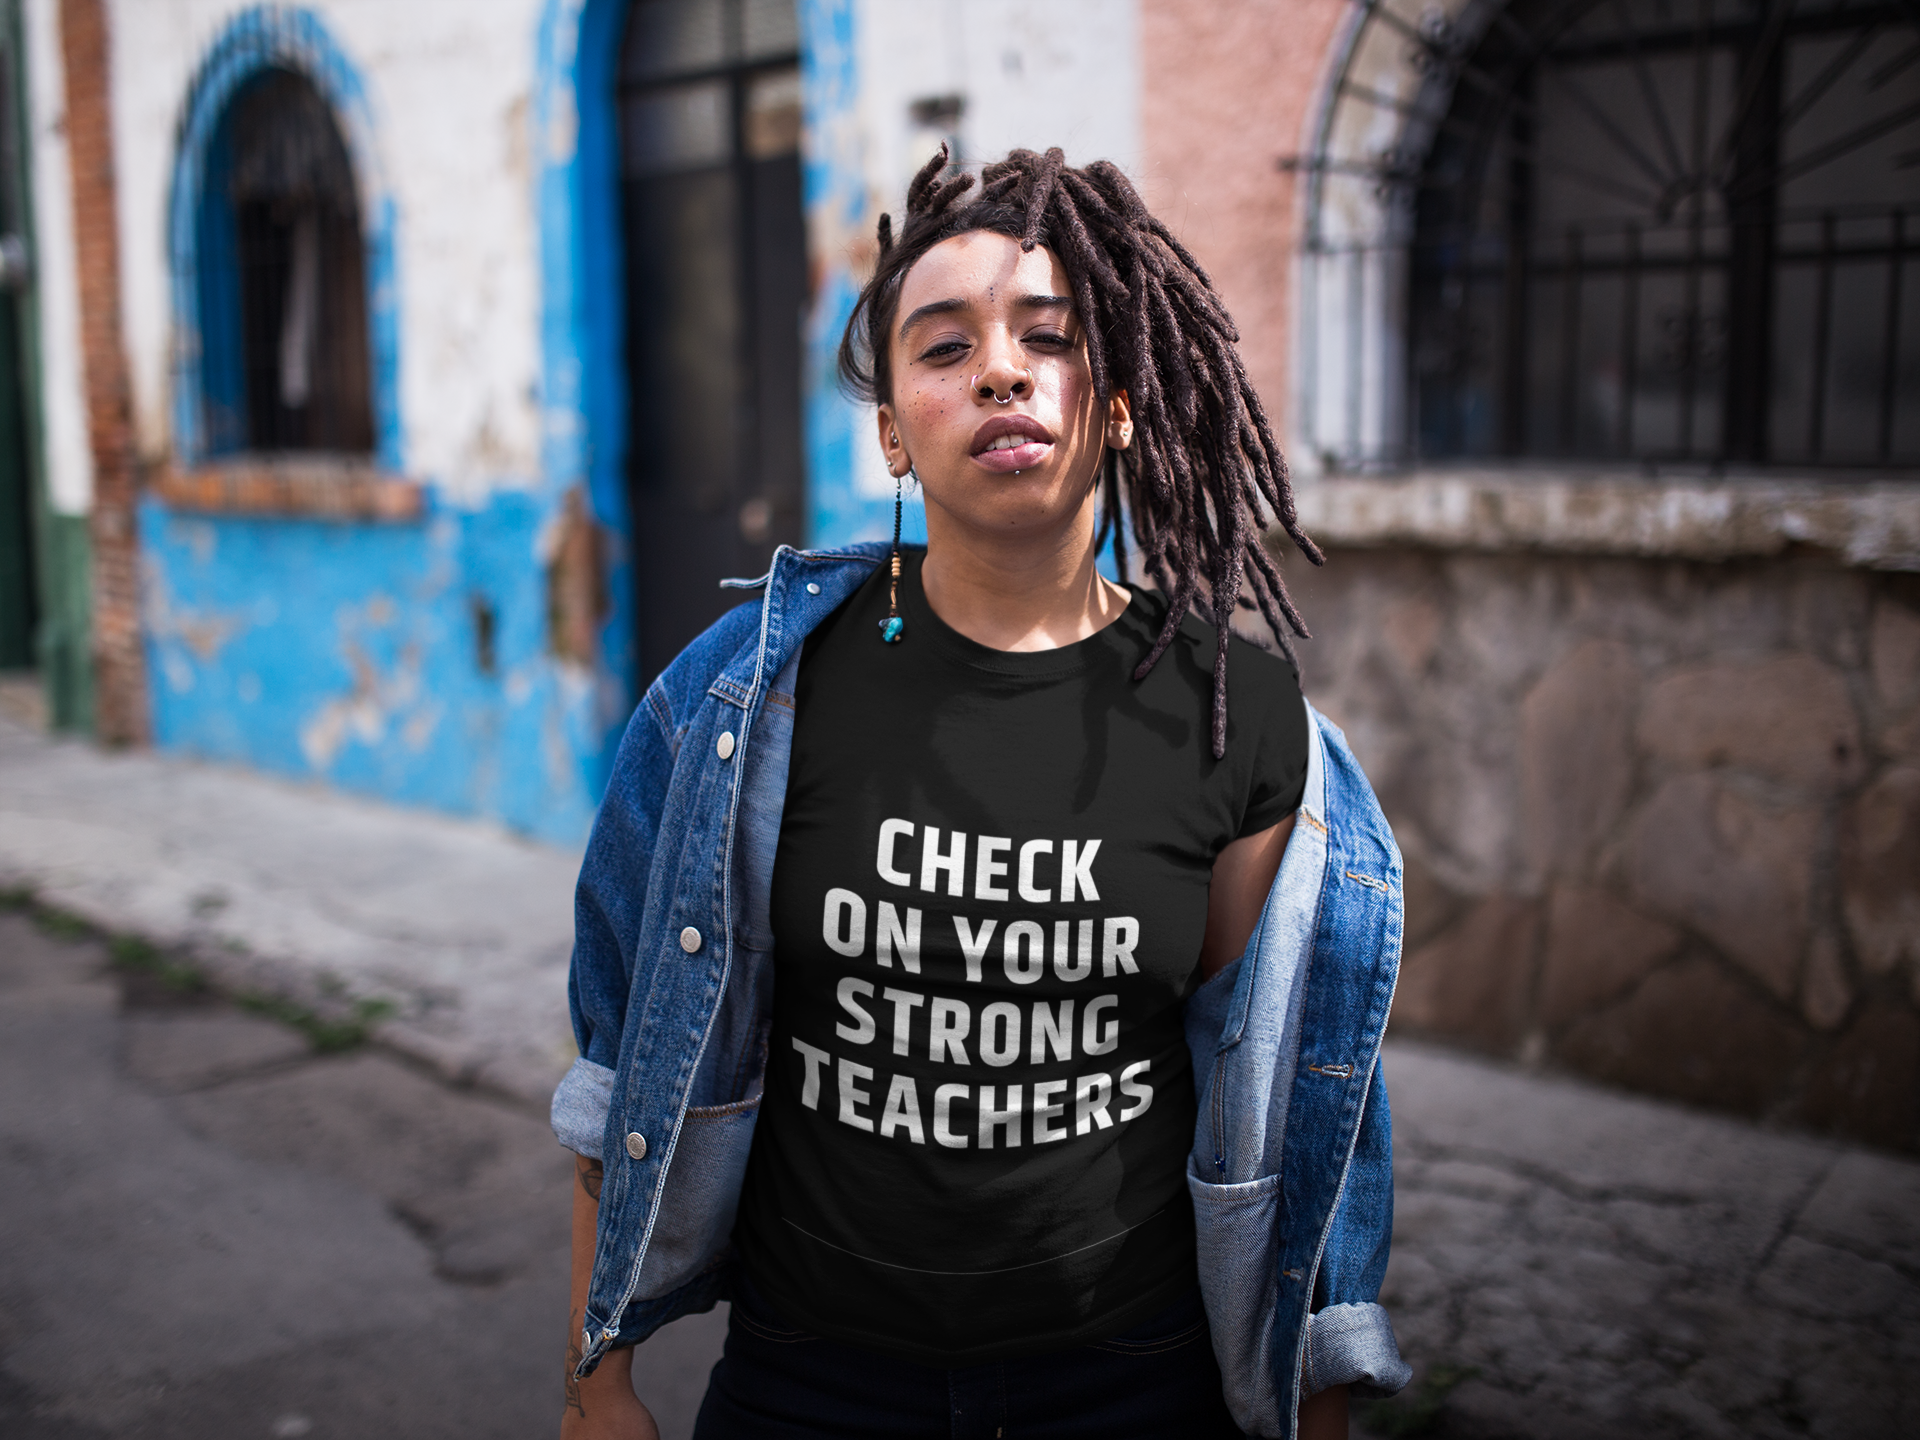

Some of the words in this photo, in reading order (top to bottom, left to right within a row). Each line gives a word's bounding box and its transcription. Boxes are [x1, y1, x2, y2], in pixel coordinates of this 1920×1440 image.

[876, 818, 1102, 903] CHECK
[822, 887, 922, 974] ON
[952, 916, 1140, 985] YOUR
[836, 976, 1119, 1067] STRONG
[792, 1036, 1154, 1149] TEACHERS
